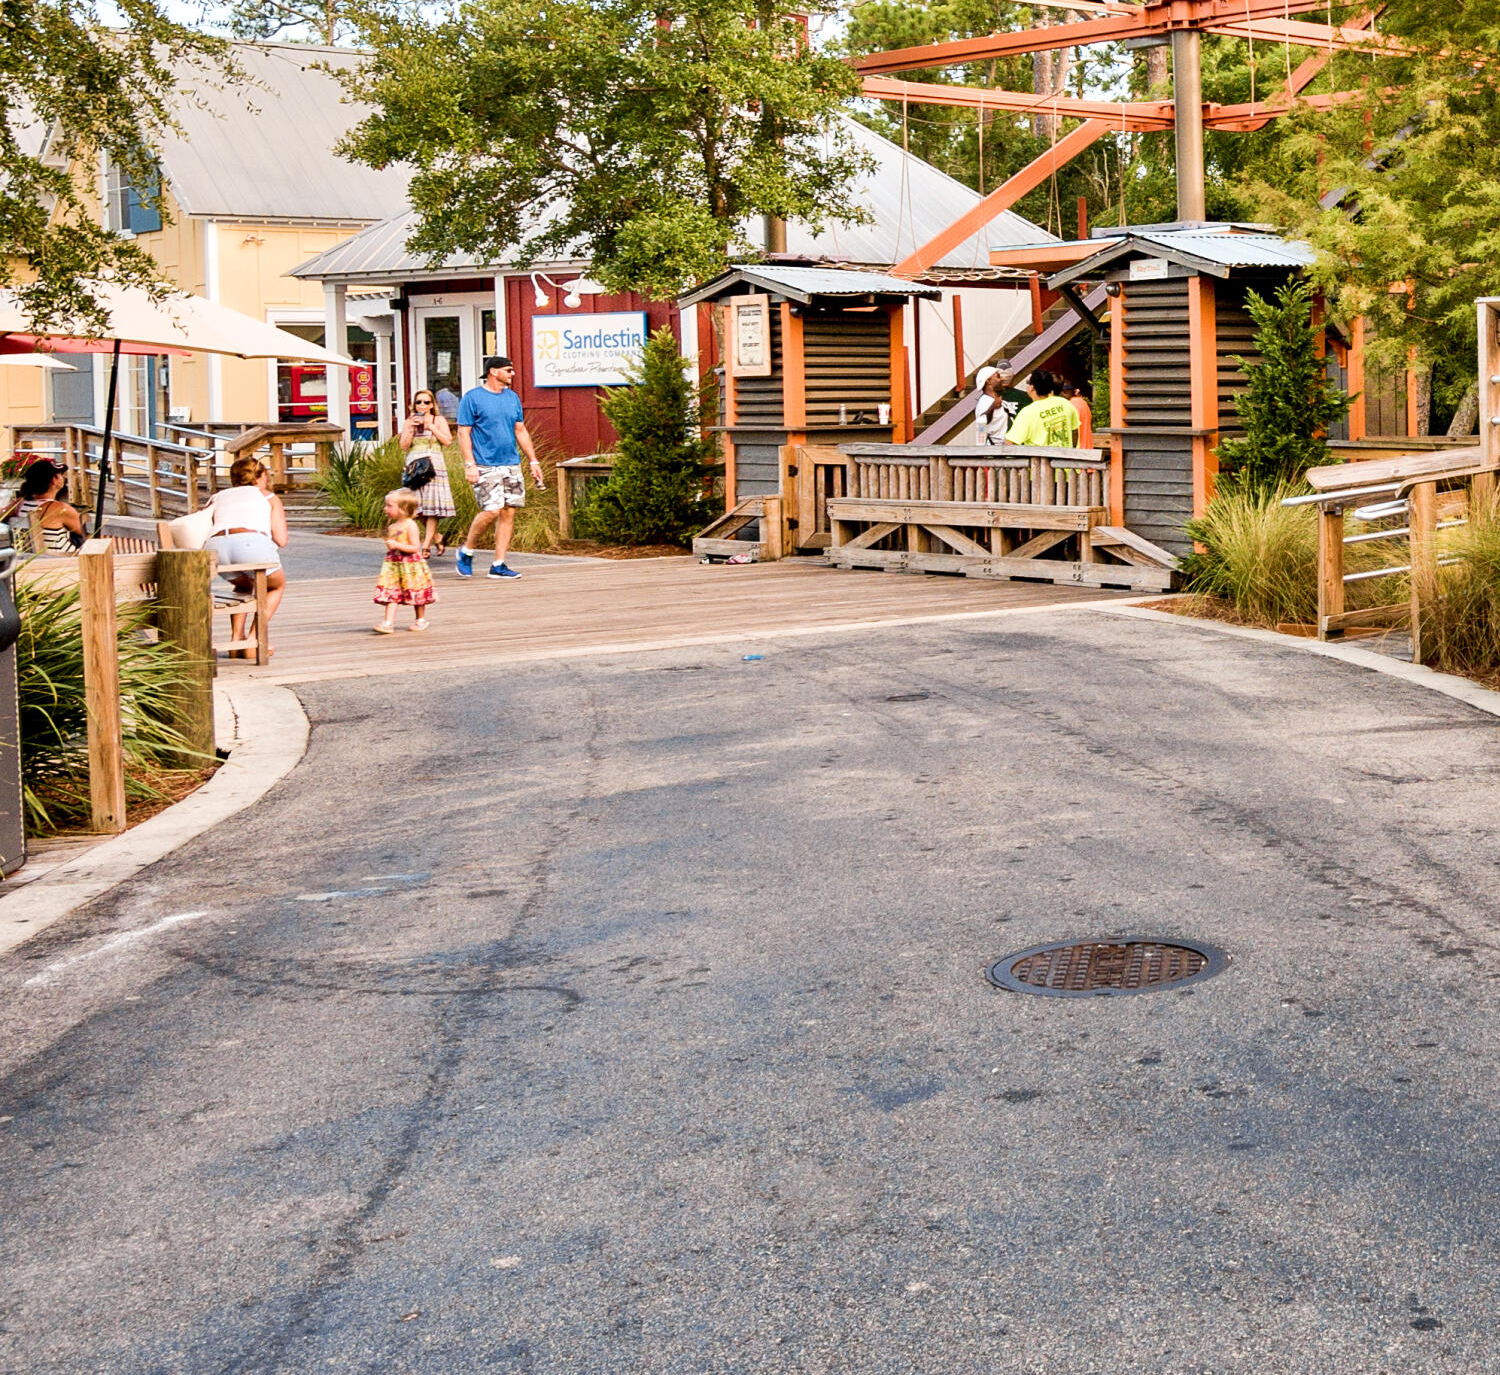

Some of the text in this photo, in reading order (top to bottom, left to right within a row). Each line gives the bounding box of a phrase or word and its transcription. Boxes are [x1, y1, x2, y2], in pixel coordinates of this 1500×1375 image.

[563, 328, 641, 349] Sandestin
[563, 349, 641, 359] CLOTHING COMPANY
[1039, 404, 1064, 419] CREW
